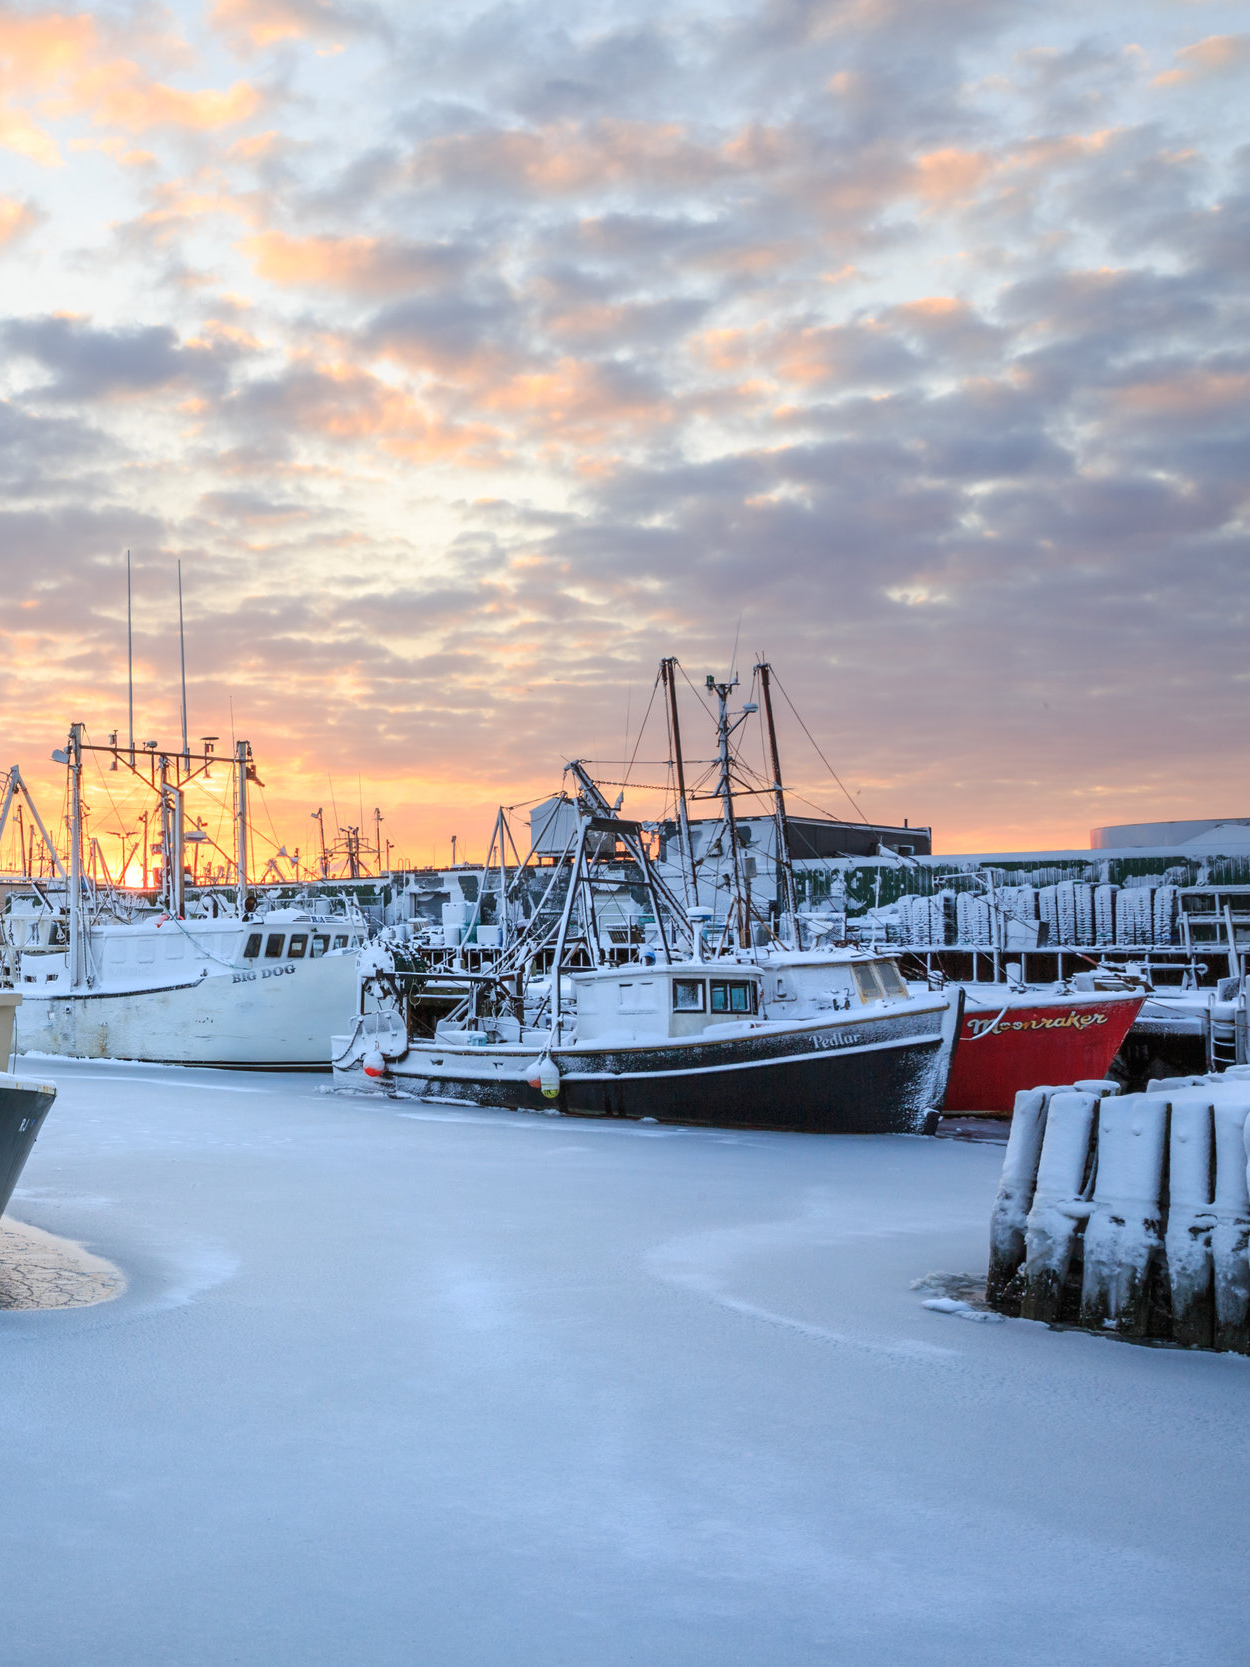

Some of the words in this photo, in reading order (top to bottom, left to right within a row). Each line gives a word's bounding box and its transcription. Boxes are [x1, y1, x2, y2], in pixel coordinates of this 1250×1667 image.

[232, 970, 258, 984] BIG
[261, 964, 297, 979] DOG
[967, 1011, 1108, 1035] Moonraker
[808, 1032, 862, 1049] Pedlar
